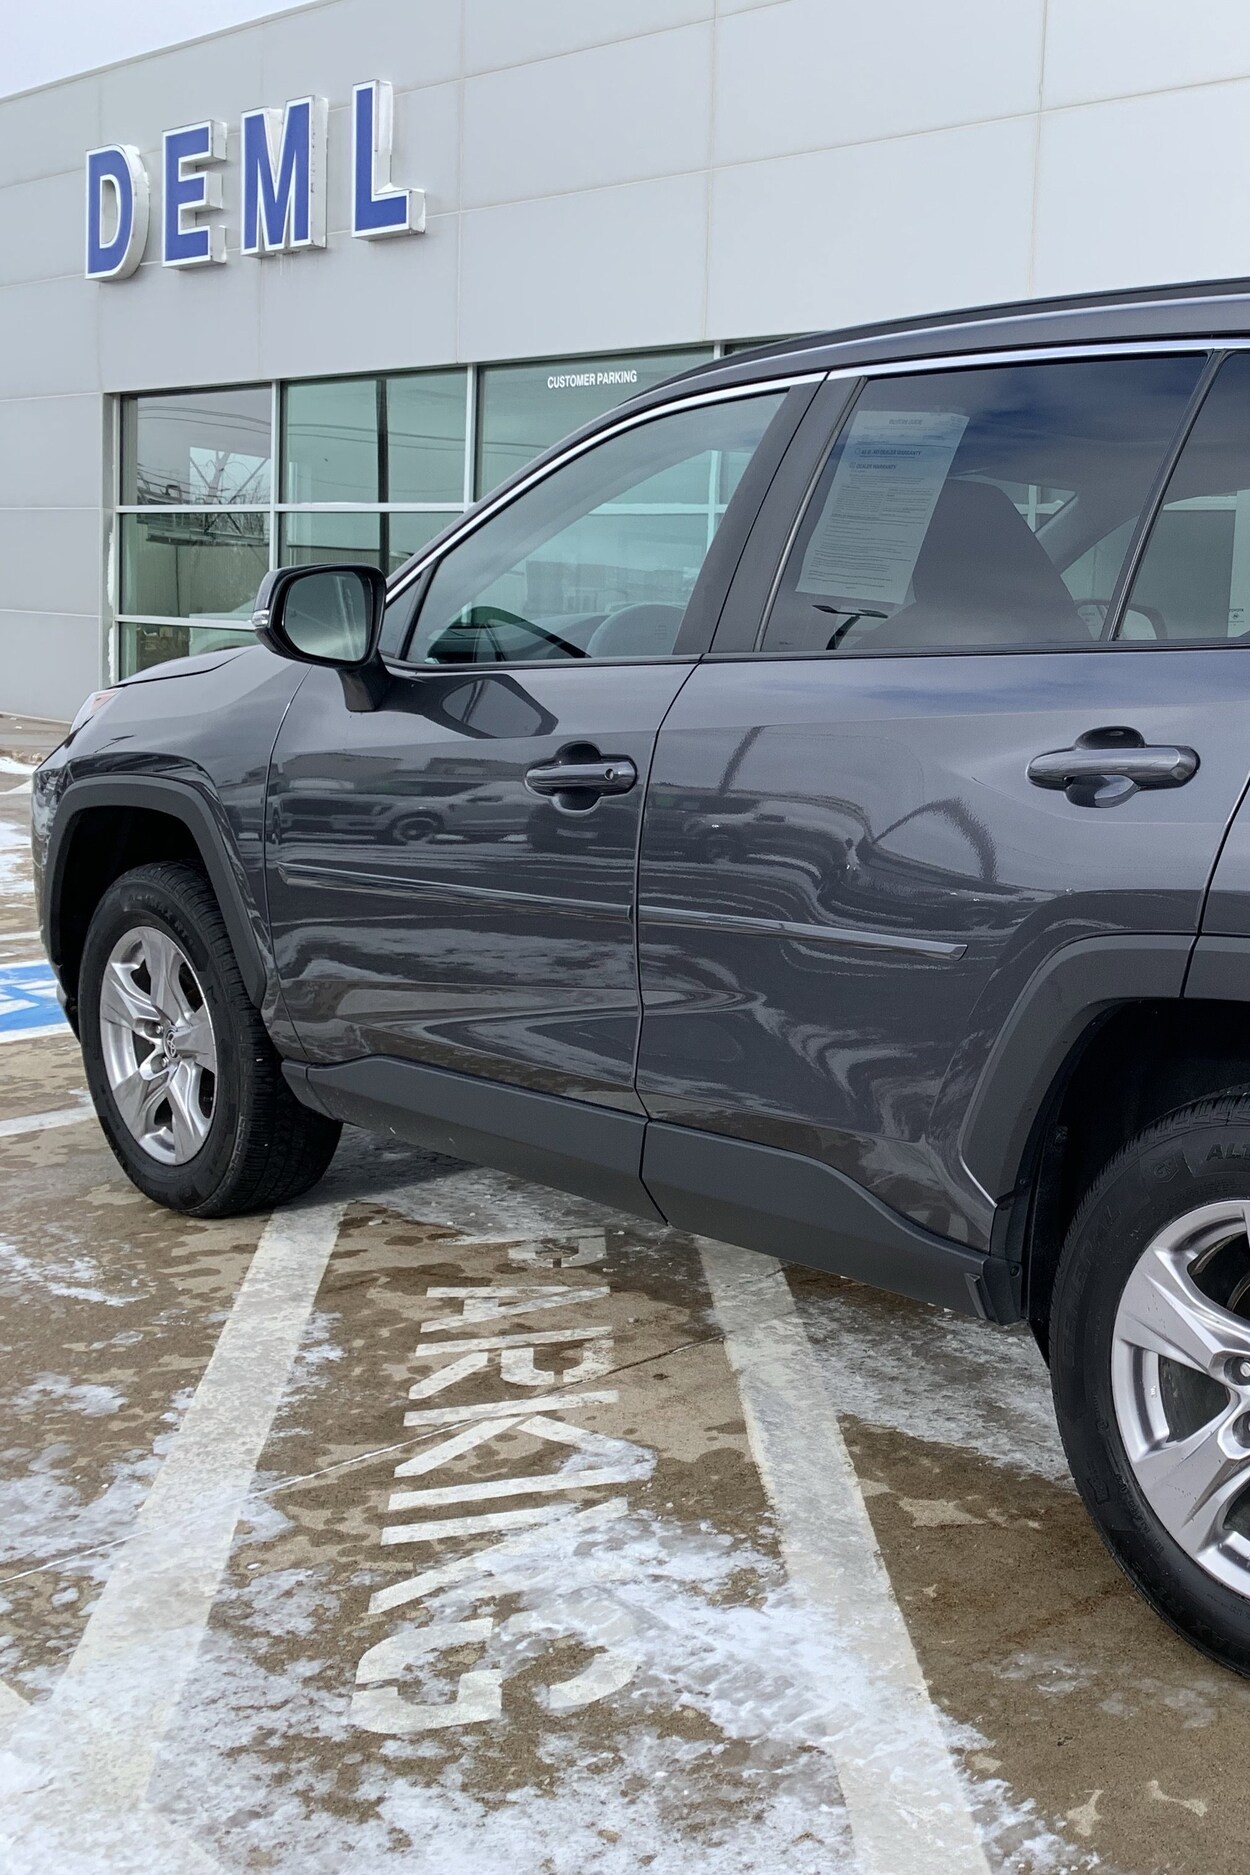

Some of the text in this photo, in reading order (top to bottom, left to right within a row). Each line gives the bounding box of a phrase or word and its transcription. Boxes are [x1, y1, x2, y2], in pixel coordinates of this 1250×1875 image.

[85, 79, 426, 281] DEML
[547, 370, 637, 389] CUSTOMER PARKING
[349, 1227, 650, 1734] PARKING
